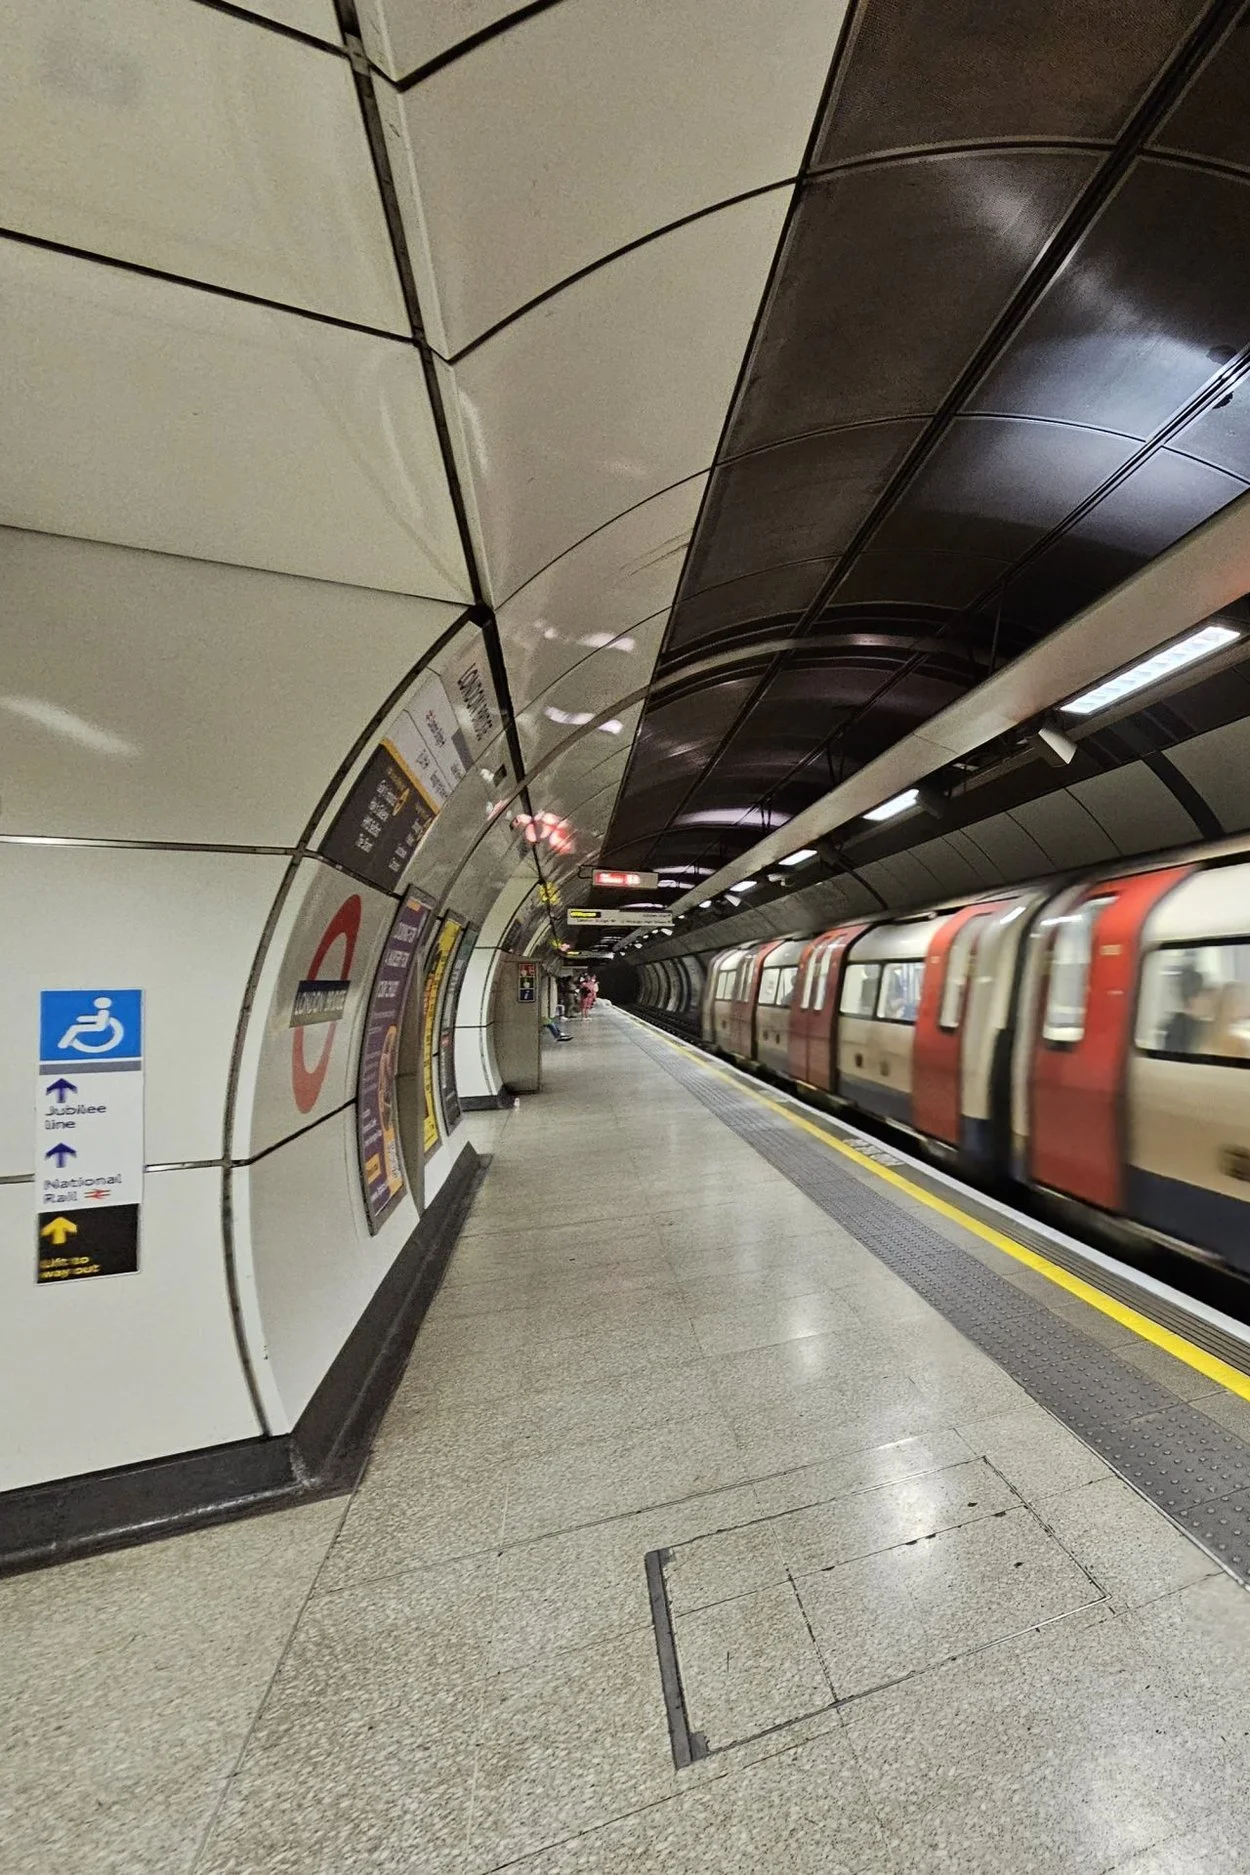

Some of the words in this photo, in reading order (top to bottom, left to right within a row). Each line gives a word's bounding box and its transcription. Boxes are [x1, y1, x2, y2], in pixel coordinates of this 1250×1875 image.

[45, 1104, 107, 1116] Jubilee
[45, 1120, 76, 1130] line
[44, 1173, 122, 1190] National
[43, 1190, 78, 1204] Rail
